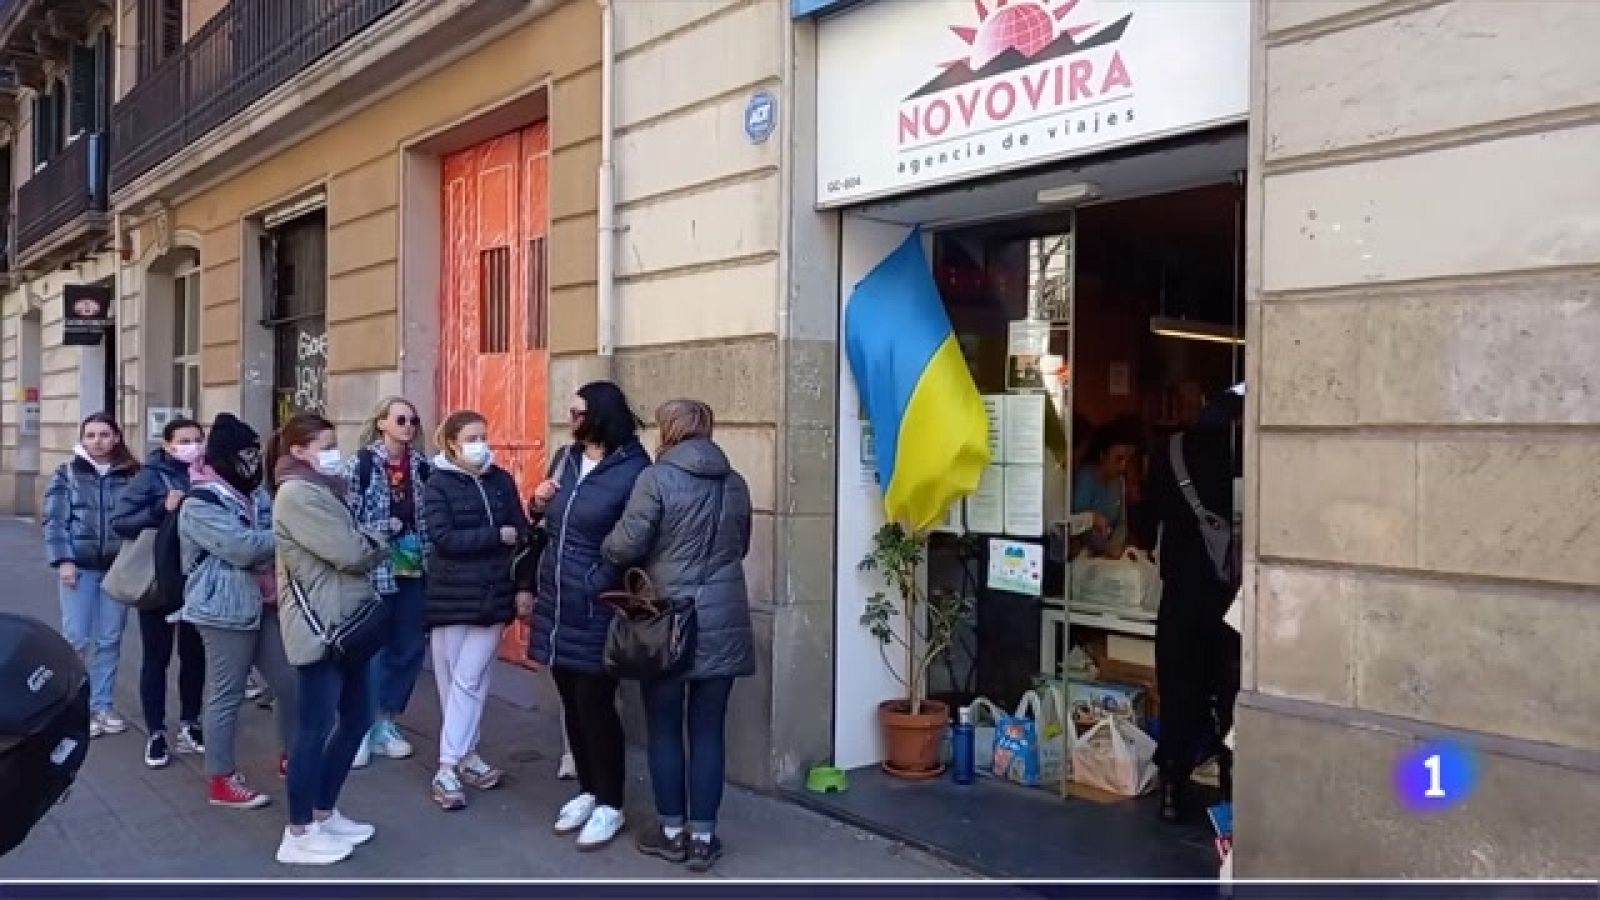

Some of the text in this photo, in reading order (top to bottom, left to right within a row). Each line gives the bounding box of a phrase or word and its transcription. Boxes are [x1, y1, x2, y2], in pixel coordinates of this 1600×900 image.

[899, 50, 1132, 143] NOVOVIRA
[898, 109, 1134, 174] agencia de viajes
